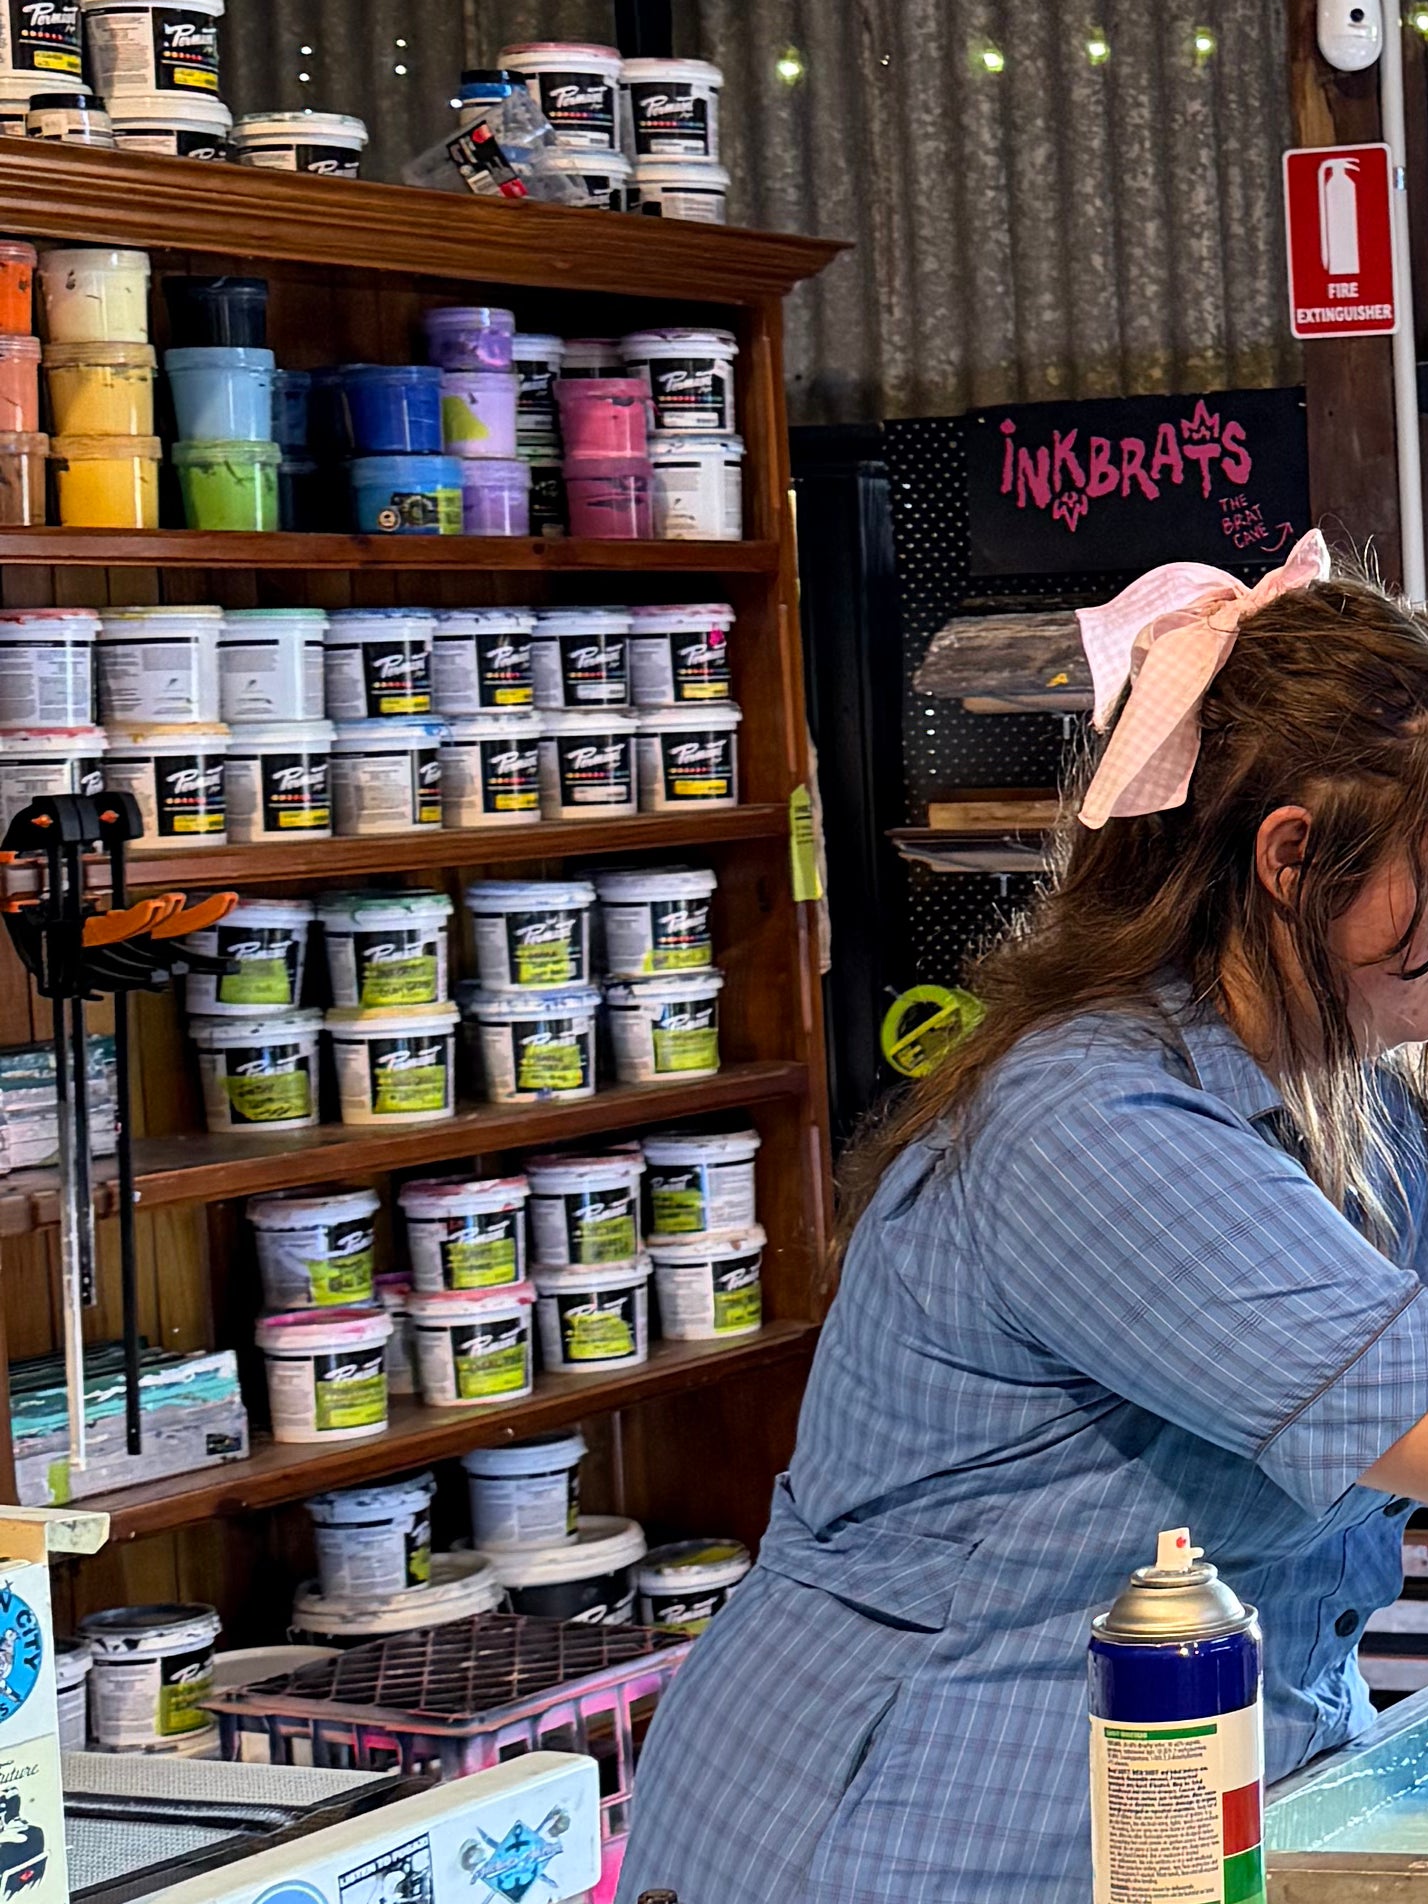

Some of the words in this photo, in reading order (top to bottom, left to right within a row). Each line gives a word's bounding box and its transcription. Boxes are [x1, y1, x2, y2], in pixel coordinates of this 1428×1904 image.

[1327, 282, 1360, 299] FIRE
[1296, 304, 1393, 324] EXTINGUISHER
[1219, 493, 1249, 511] THE
[1222, 502, 1264, 534] BRAT
[1233, 524, 1270, 550] CAVE
[16, 1609, 42, 1671] CITY
